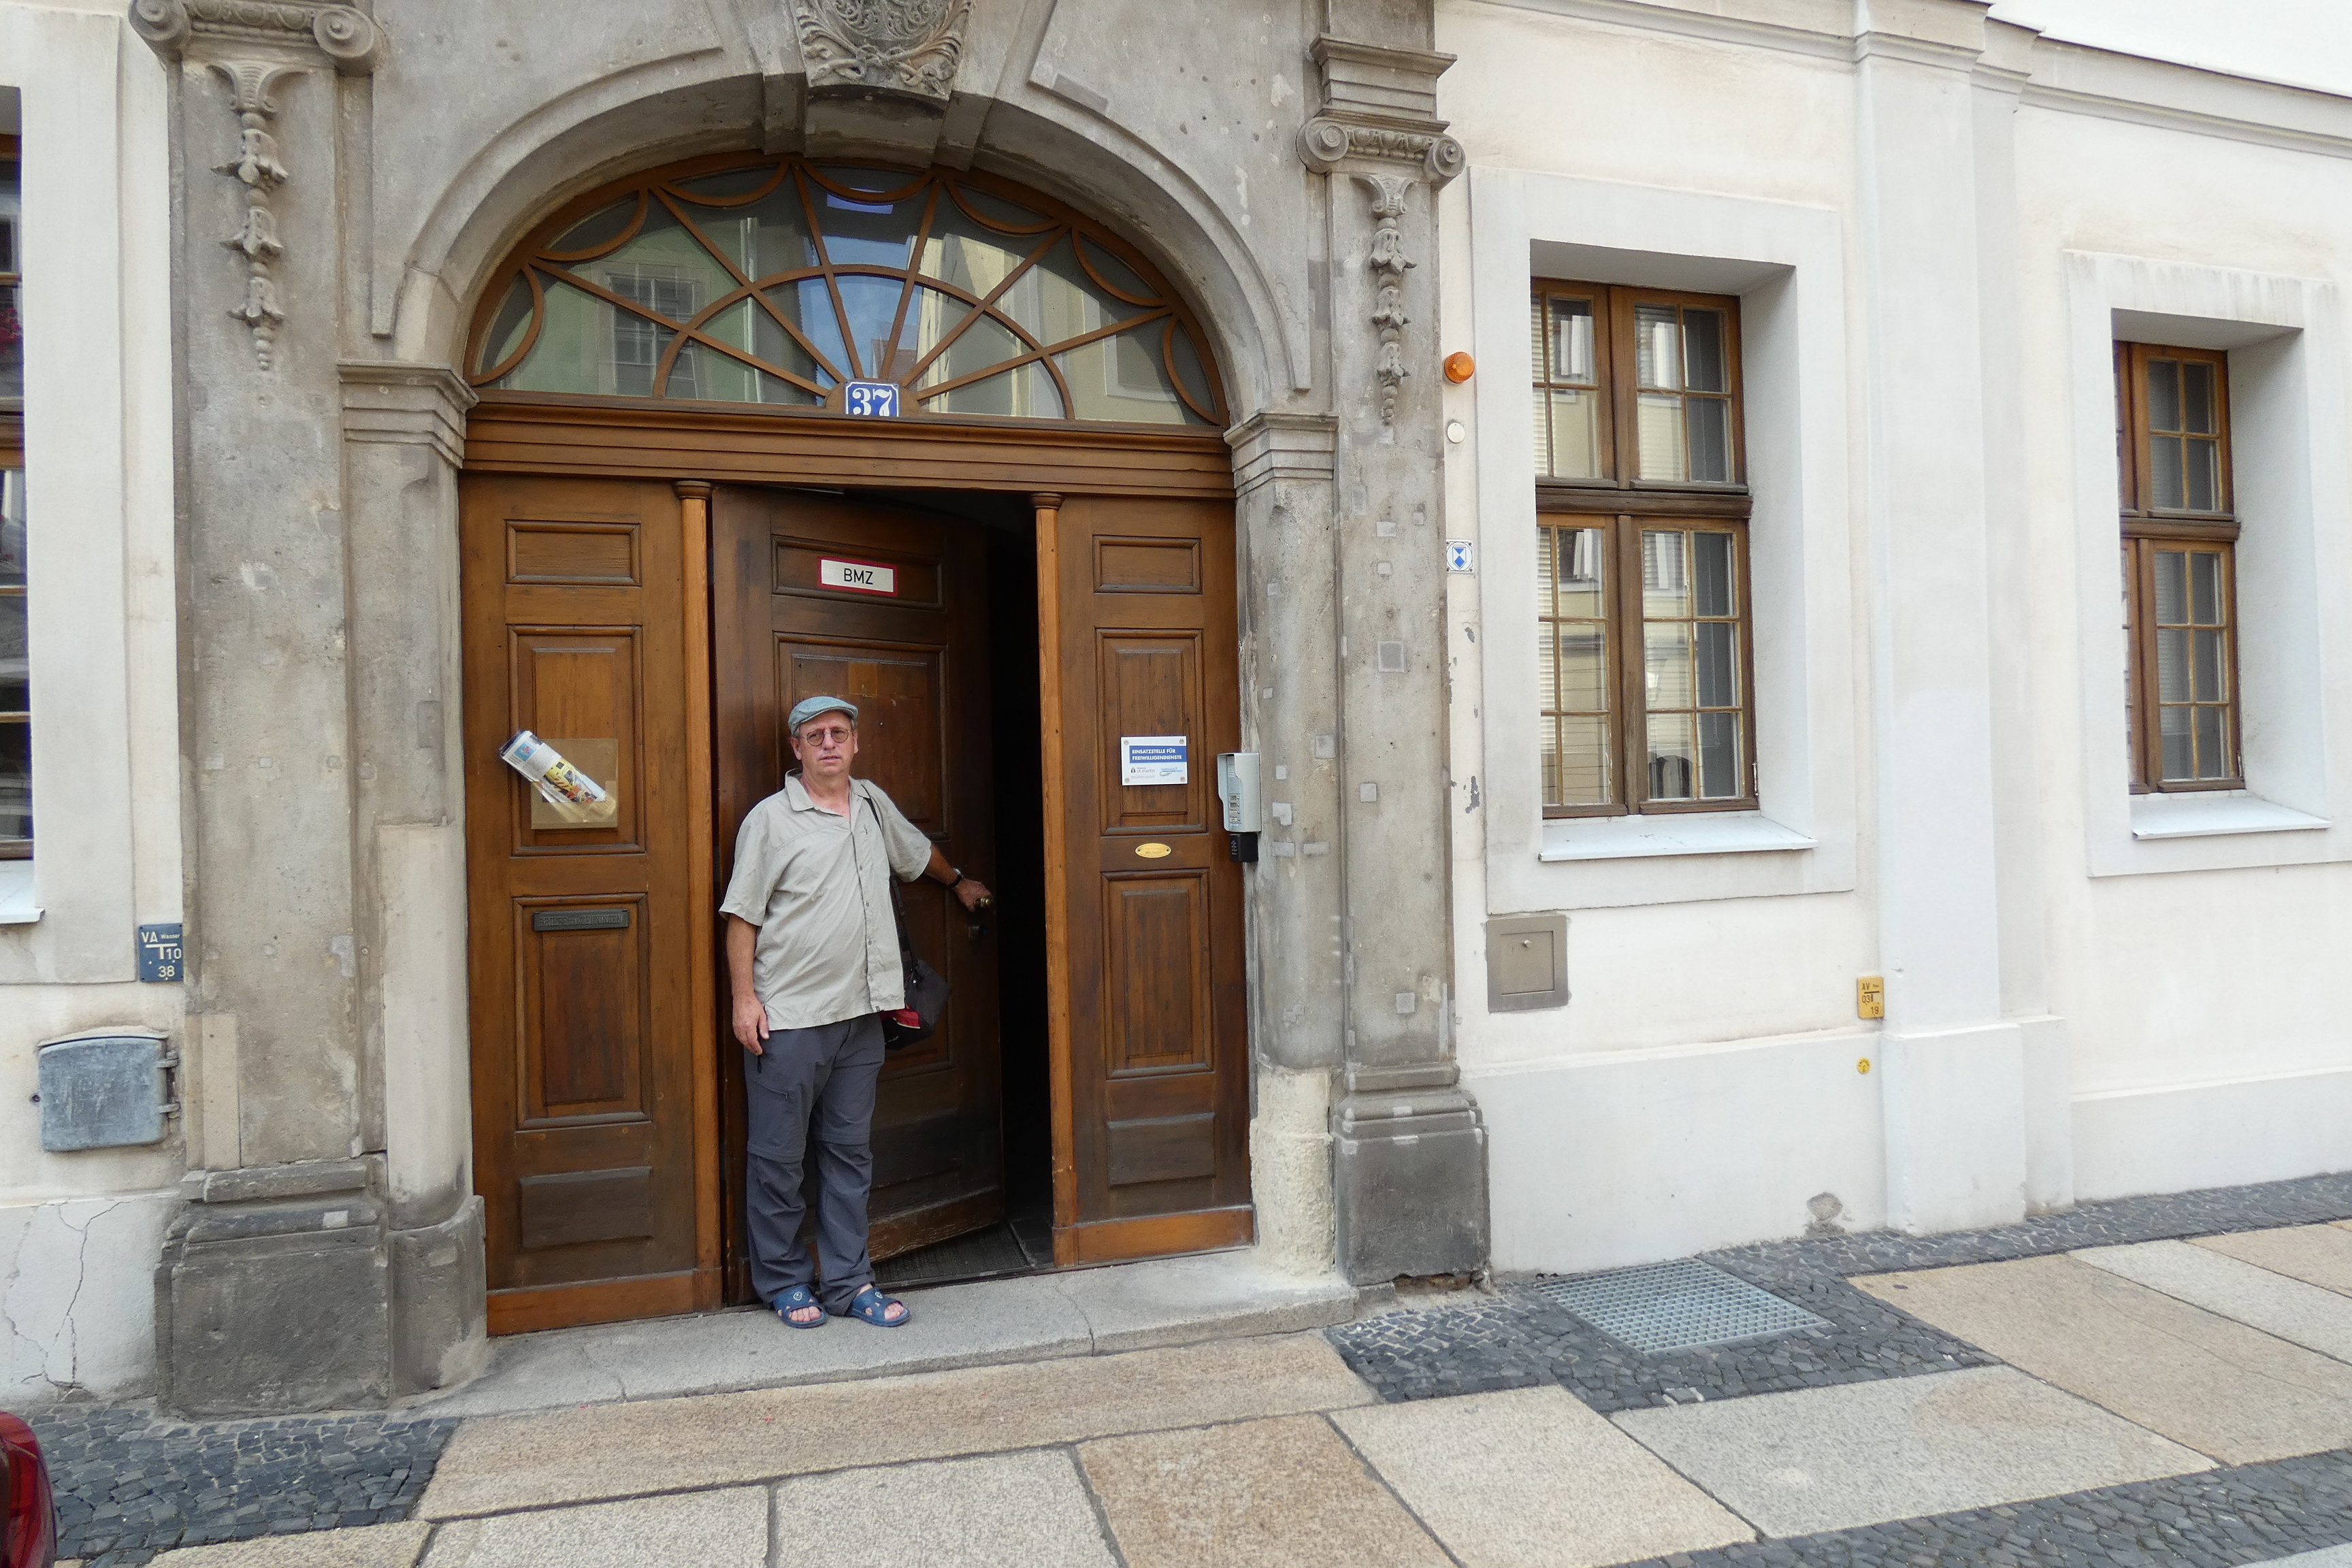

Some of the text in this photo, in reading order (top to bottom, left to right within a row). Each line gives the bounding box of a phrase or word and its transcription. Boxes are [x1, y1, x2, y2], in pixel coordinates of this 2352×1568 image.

[852, 388, 892, 416] 37
[844, 568, 873, 585] BMZ
[142, 931, 158, 943] VA
[158, 965, 175, 977] 38
[1861, 982, 1870, 991] AV
[1871, 1006, 1879, 1014] 19
